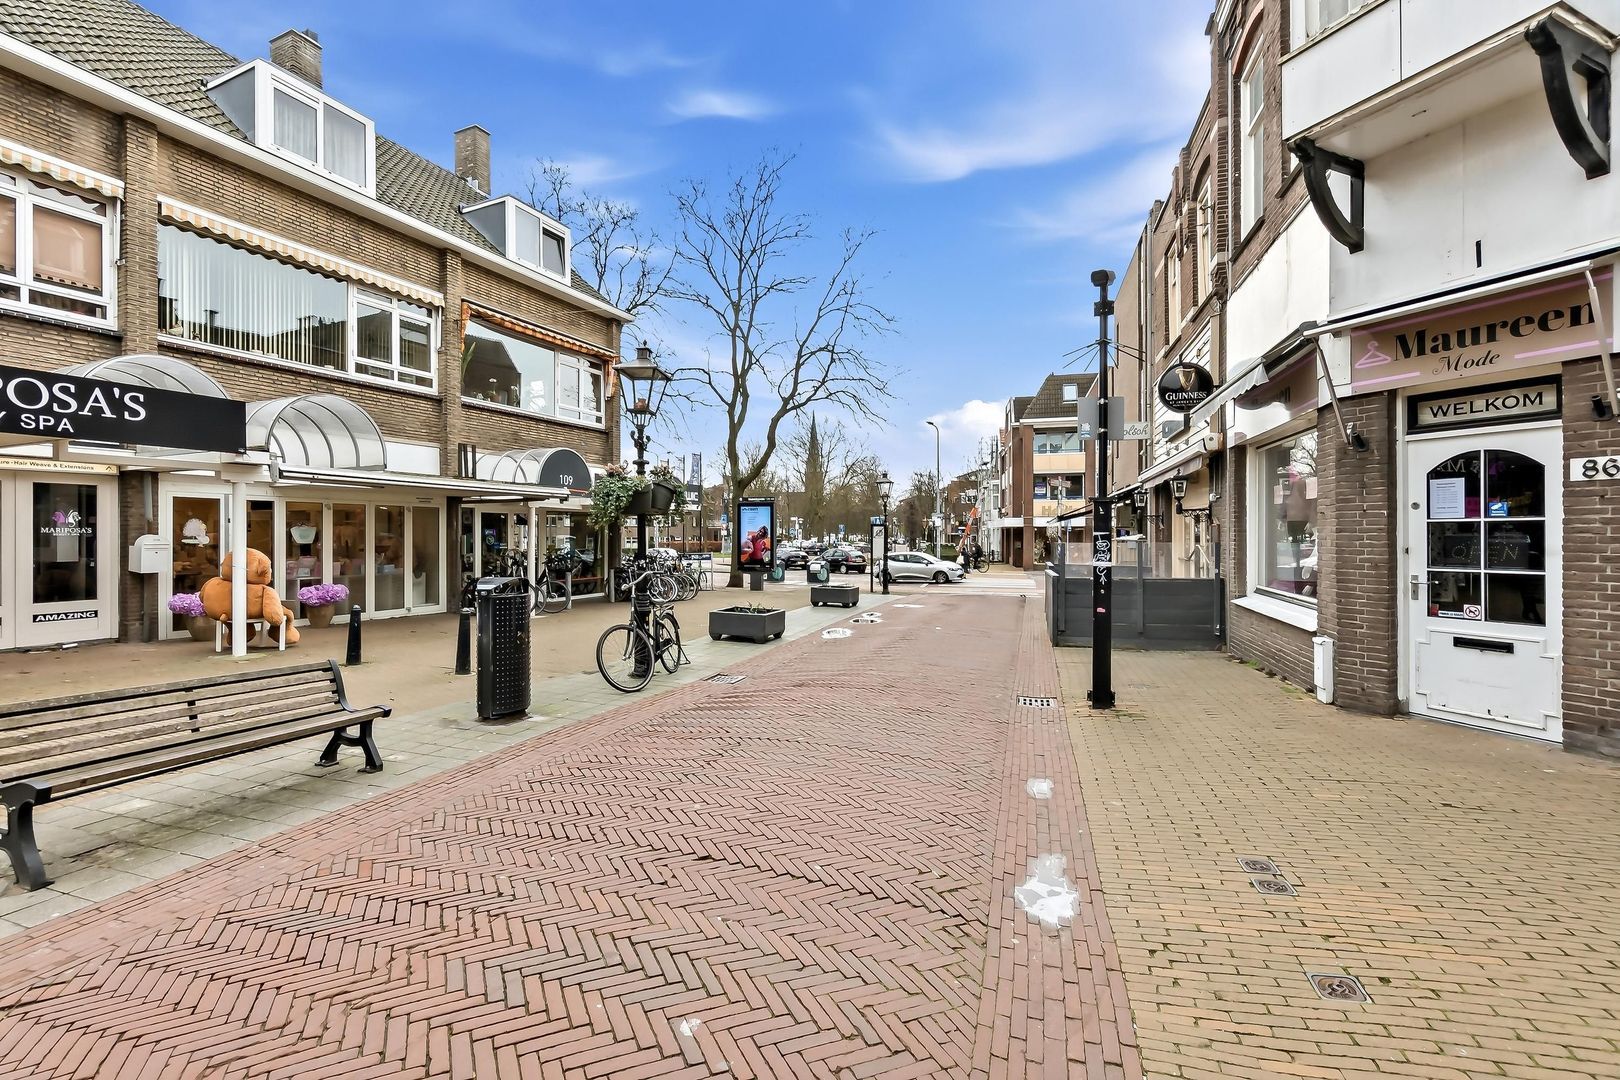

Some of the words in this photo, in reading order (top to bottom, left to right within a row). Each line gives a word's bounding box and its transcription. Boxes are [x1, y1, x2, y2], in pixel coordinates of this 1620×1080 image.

[1394, 302, 1596, 361] Maureen
[1431, 350, 1501, 375] Mode
[0, 377, 147, 421] OSA'S
[1165, 391, 1207, 400] GUINNESS
[1429, 391, 1543, 418] WELKOM
[20, 413, 74, 433] SPA
[1582, 457, 1620, 479] 86
[559, 474, 573, 485] 109
[35, 611, 96, 622] AMAZING
